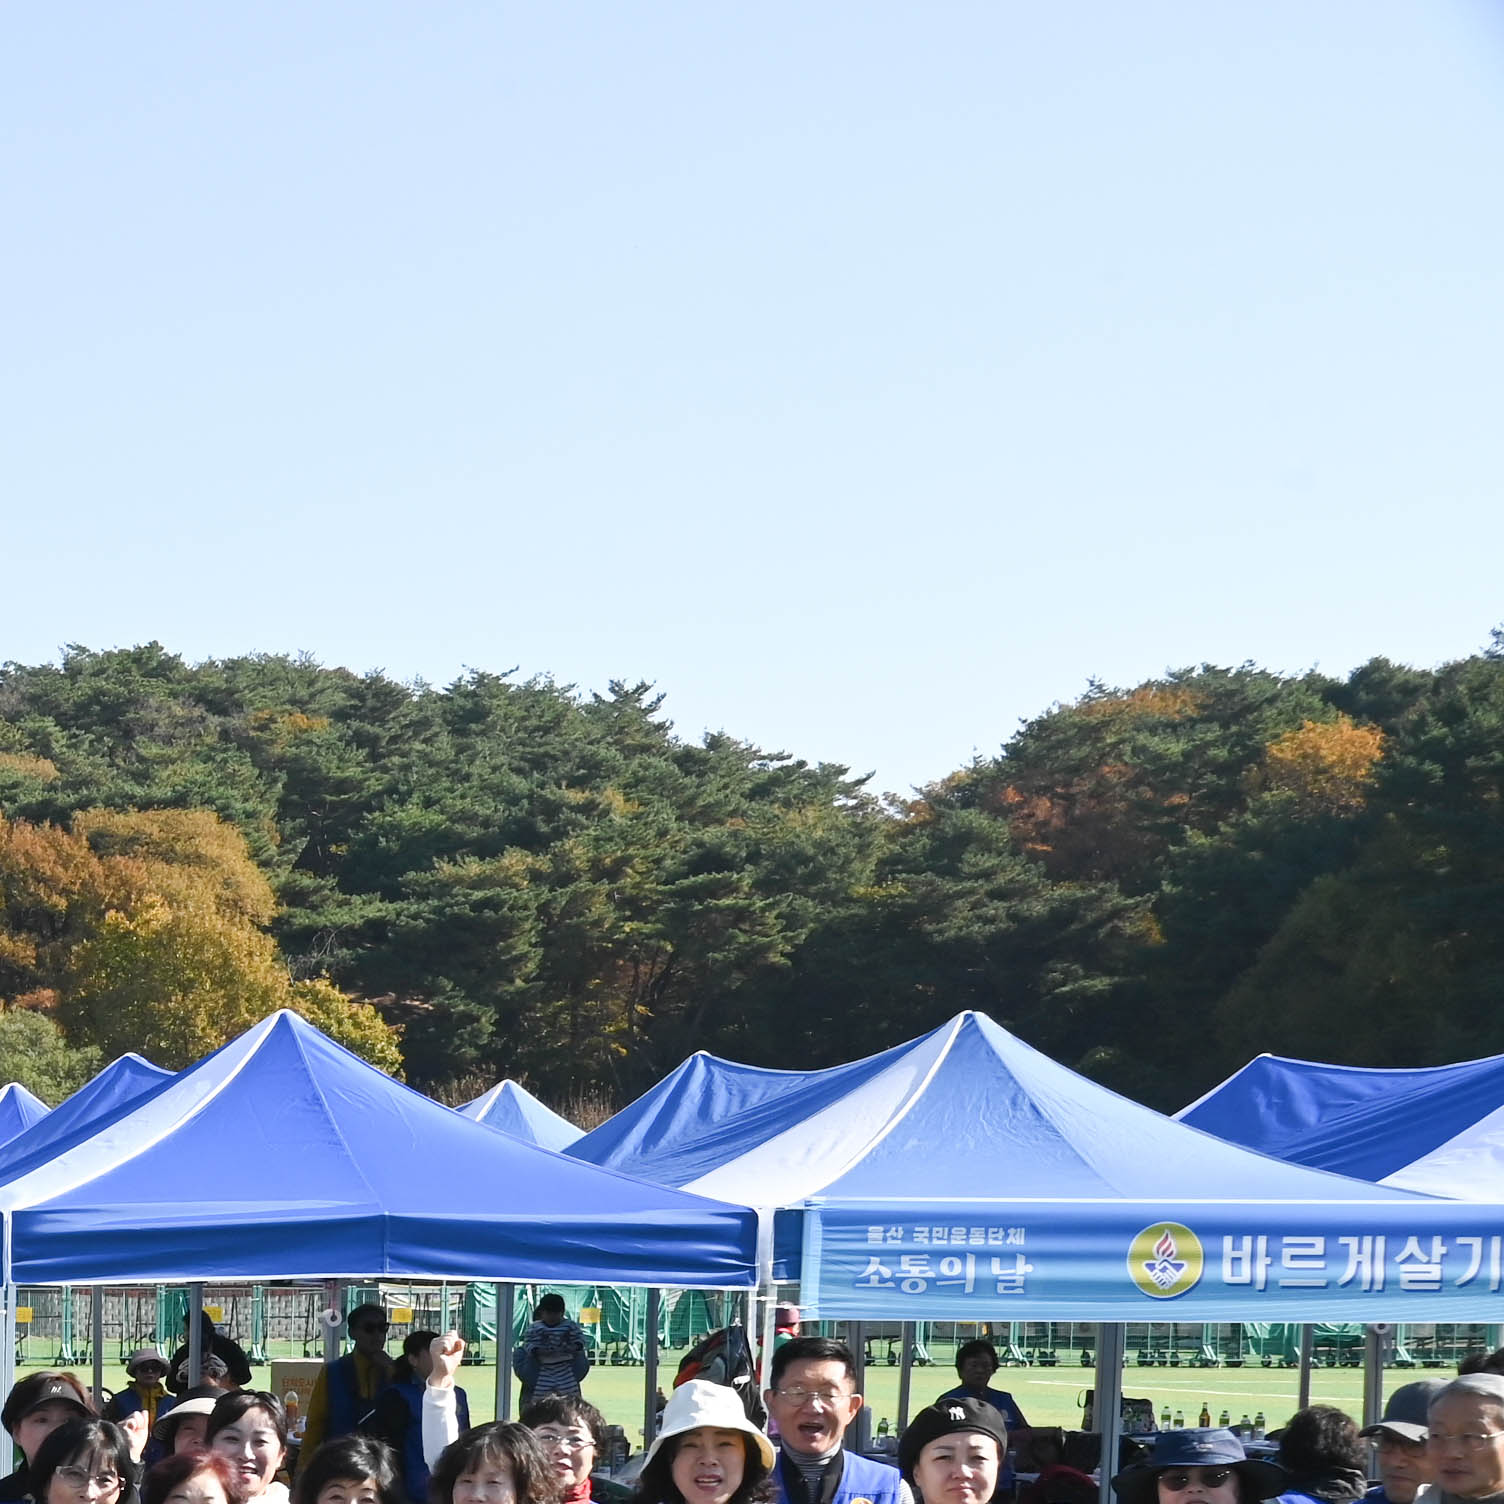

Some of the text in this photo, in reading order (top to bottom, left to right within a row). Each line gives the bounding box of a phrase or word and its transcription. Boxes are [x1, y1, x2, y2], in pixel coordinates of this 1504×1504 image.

[867, 1226, 1026, 1246] 울산 국민운동단체
[854, 1252, 1034, 1295] 소통의 날
